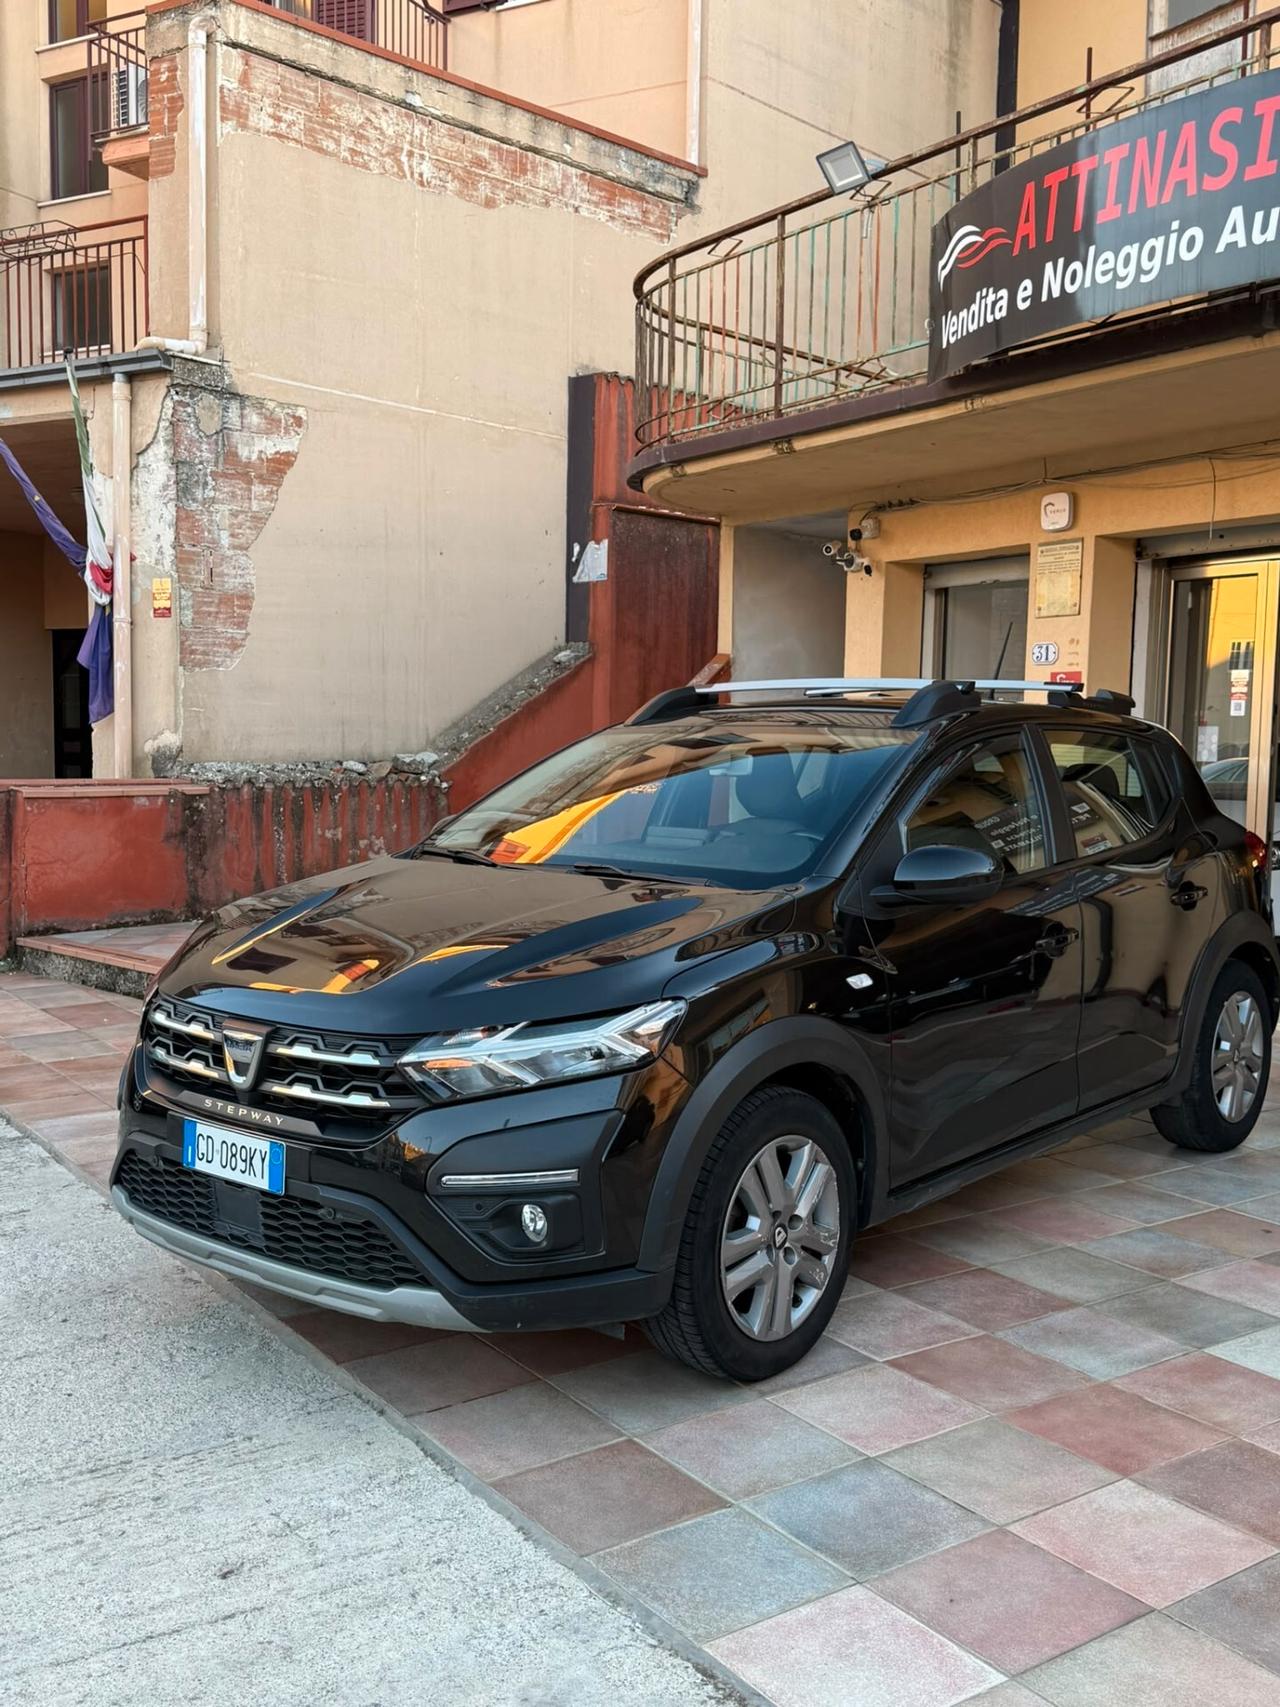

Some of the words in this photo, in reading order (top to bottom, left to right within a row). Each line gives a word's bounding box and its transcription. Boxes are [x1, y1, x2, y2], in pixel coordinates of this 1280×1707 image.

[1012, 95, 1280, 257] ATTINASI
[942, 287, 1009, 349] Vendita
[1016, 278, 1033, 311] e
[1041, 219, 1204, 303] Noleggio
[1215, 204, 1280, 254] Au
[1035, 645, 1050, 662] 31
[204, 1098, 284, 1126] STEPWAY
